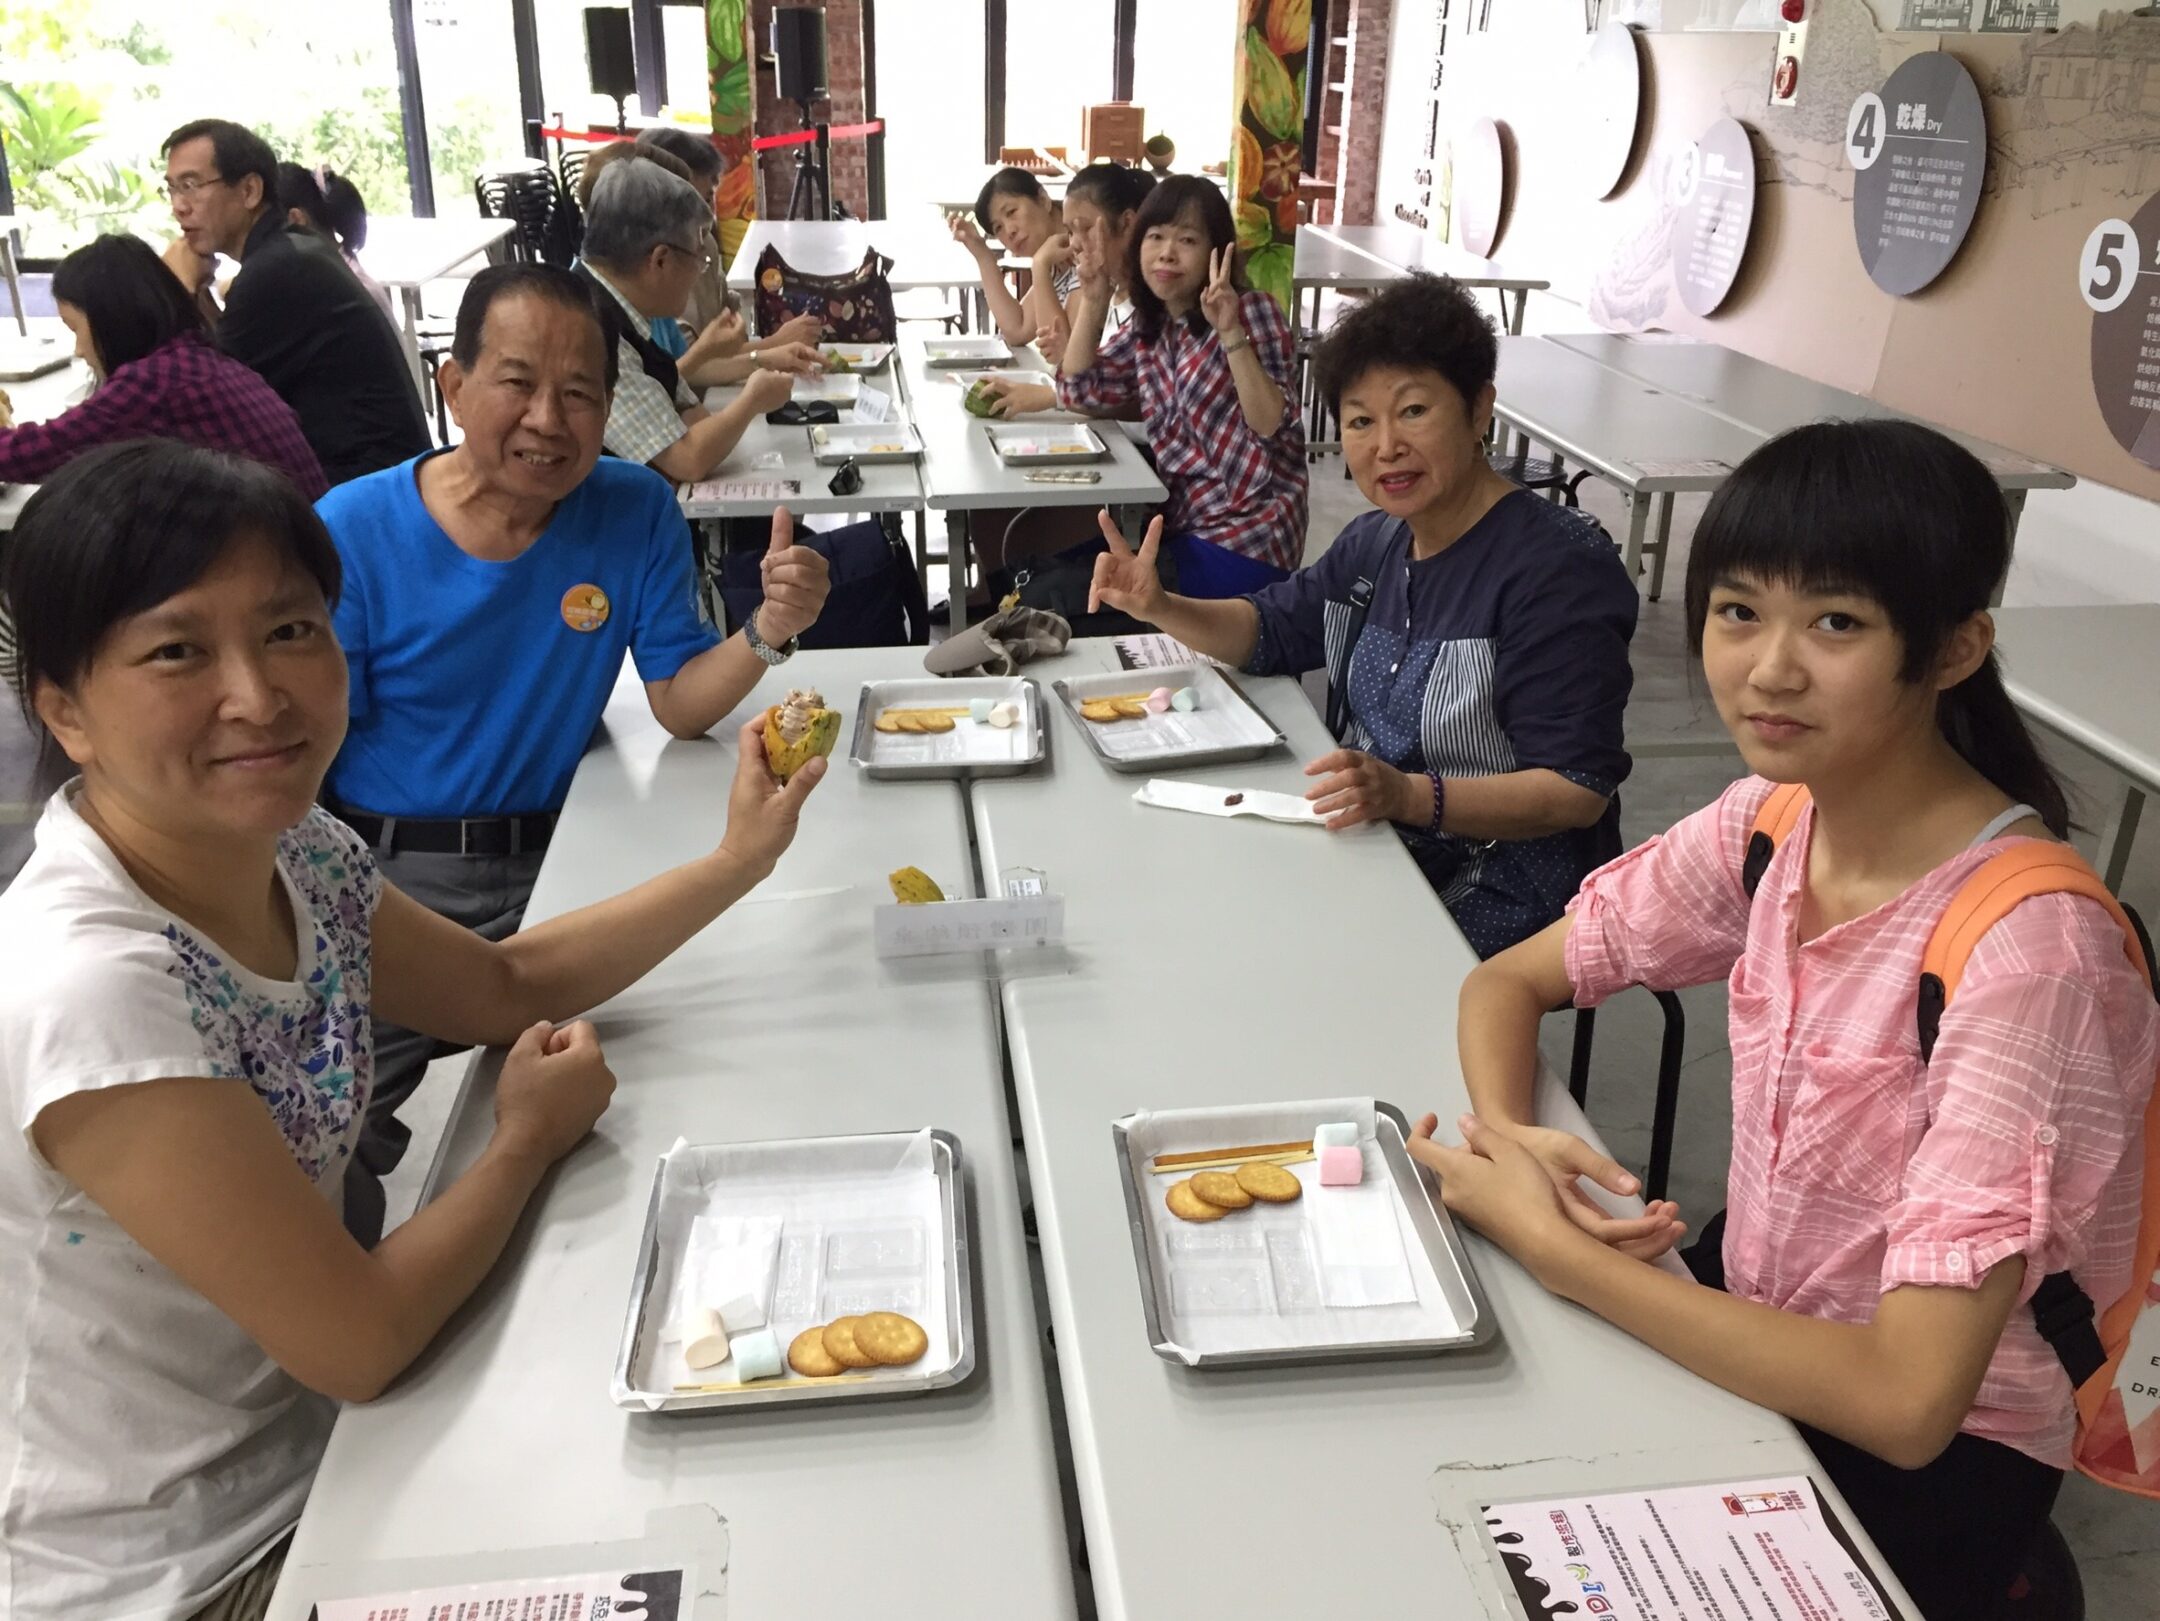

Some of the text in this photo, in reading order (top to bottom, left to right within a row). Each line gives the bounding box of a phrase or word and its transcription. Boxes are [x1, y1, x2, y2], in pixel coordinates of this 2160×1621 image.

[1852, 104, 1877, 159] 4
[1896, 102, 1943, 134] 乾燥 Dry
[2089, 233, 2125, 300] 5
[2132, 1382, 2160, 1399] DR
[1549, 1510, 1614, 1621] DIY 製作流程
[596, 1595, 611, 1621] 巧克
